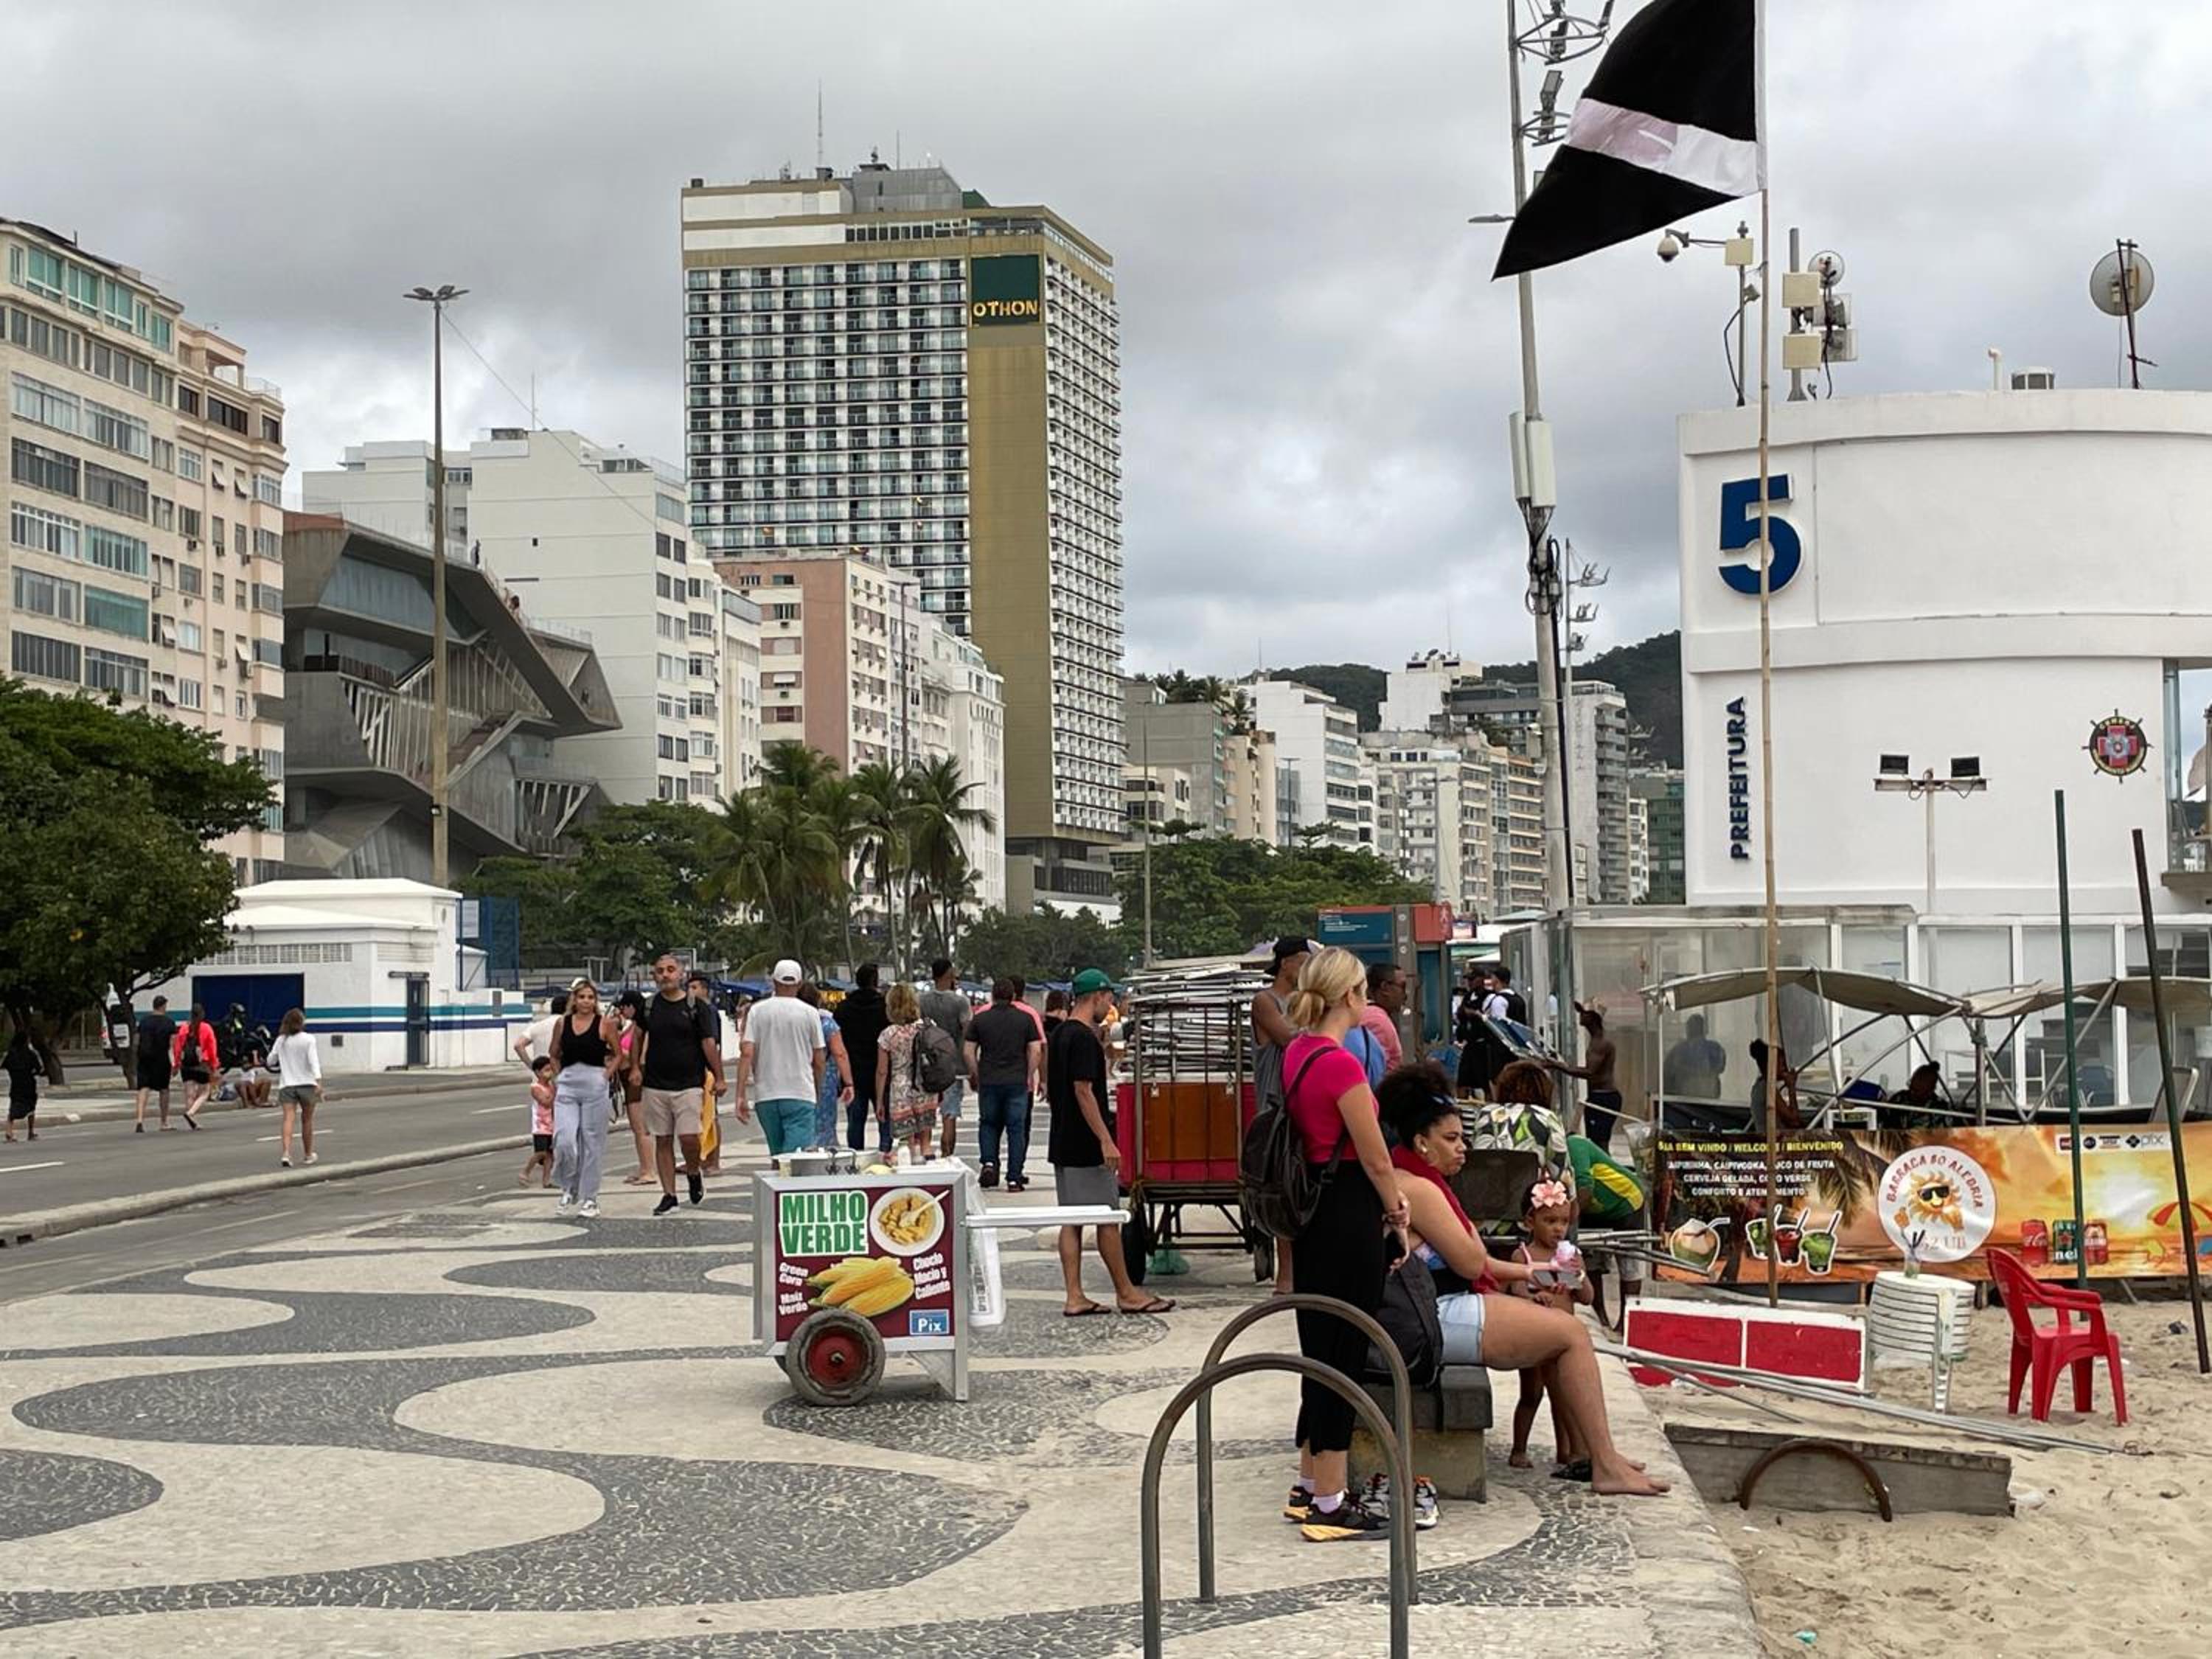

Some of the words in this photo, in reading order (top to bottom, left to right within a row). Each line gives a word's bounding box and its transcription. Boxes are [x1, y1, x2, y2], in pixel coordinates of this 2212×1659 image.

[973, 299, 1038, 317] OTHON
[1718, 474, 1801, 595] 5
[1726, 696, 1750, 860] PREFEITURA
[1697, 1142, 1727, 1152] VINDO
[1733, 1142, 1780, 1152] WELCOE
[1775, 1161, 1792, 1169] UCO
[1794, 1161, 1805, 1169] DE
[1807, 1160, 1835, 1169] FRUTA
[1948, 1160, 1984, 1208] ALEGRIA
[782, 1192, 866, 1224] MILHO
[782, 1222, 866, 1254] VERDE
[918, 1318, 942, 1332] Pix
